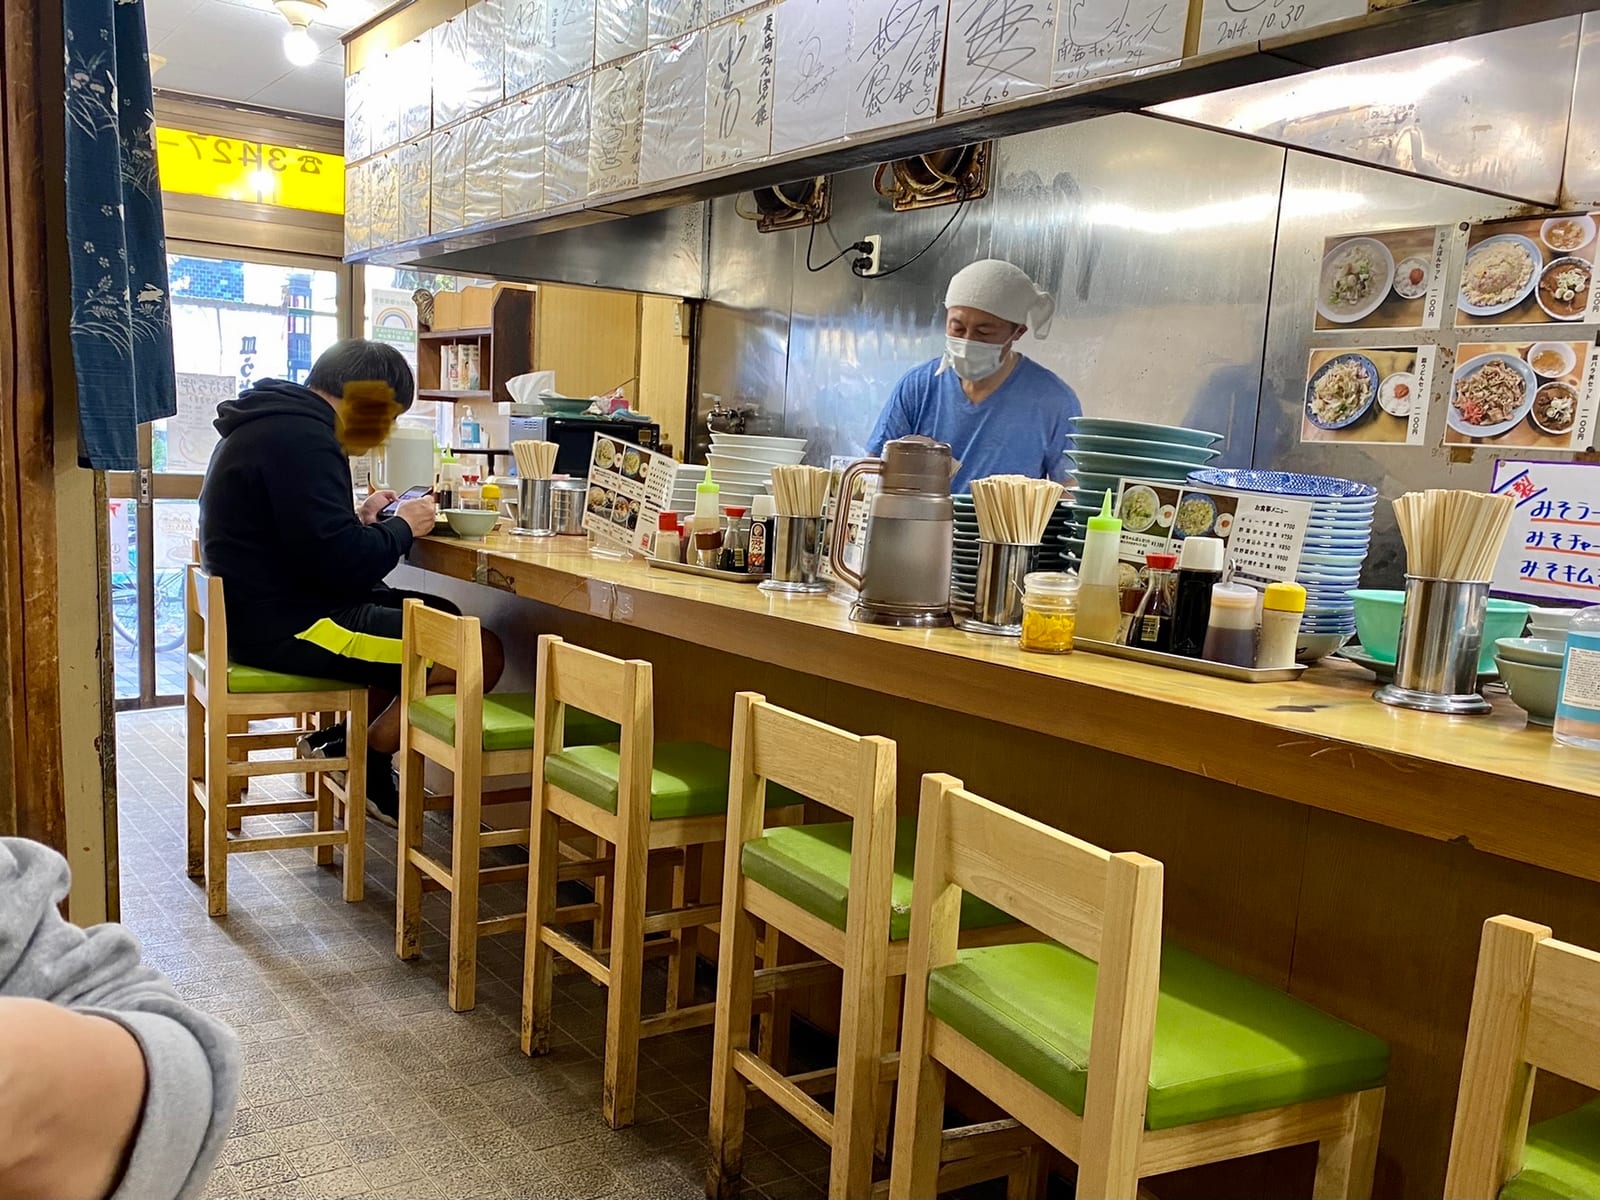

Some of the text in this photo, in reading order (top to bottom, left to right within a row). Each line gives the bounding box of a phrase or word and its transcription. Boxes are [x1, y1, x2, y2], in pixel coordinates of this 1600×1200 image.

[1254, 504, 1289, 514] お食事メニュー
[1520, 560, 1600, 584] みそキム
